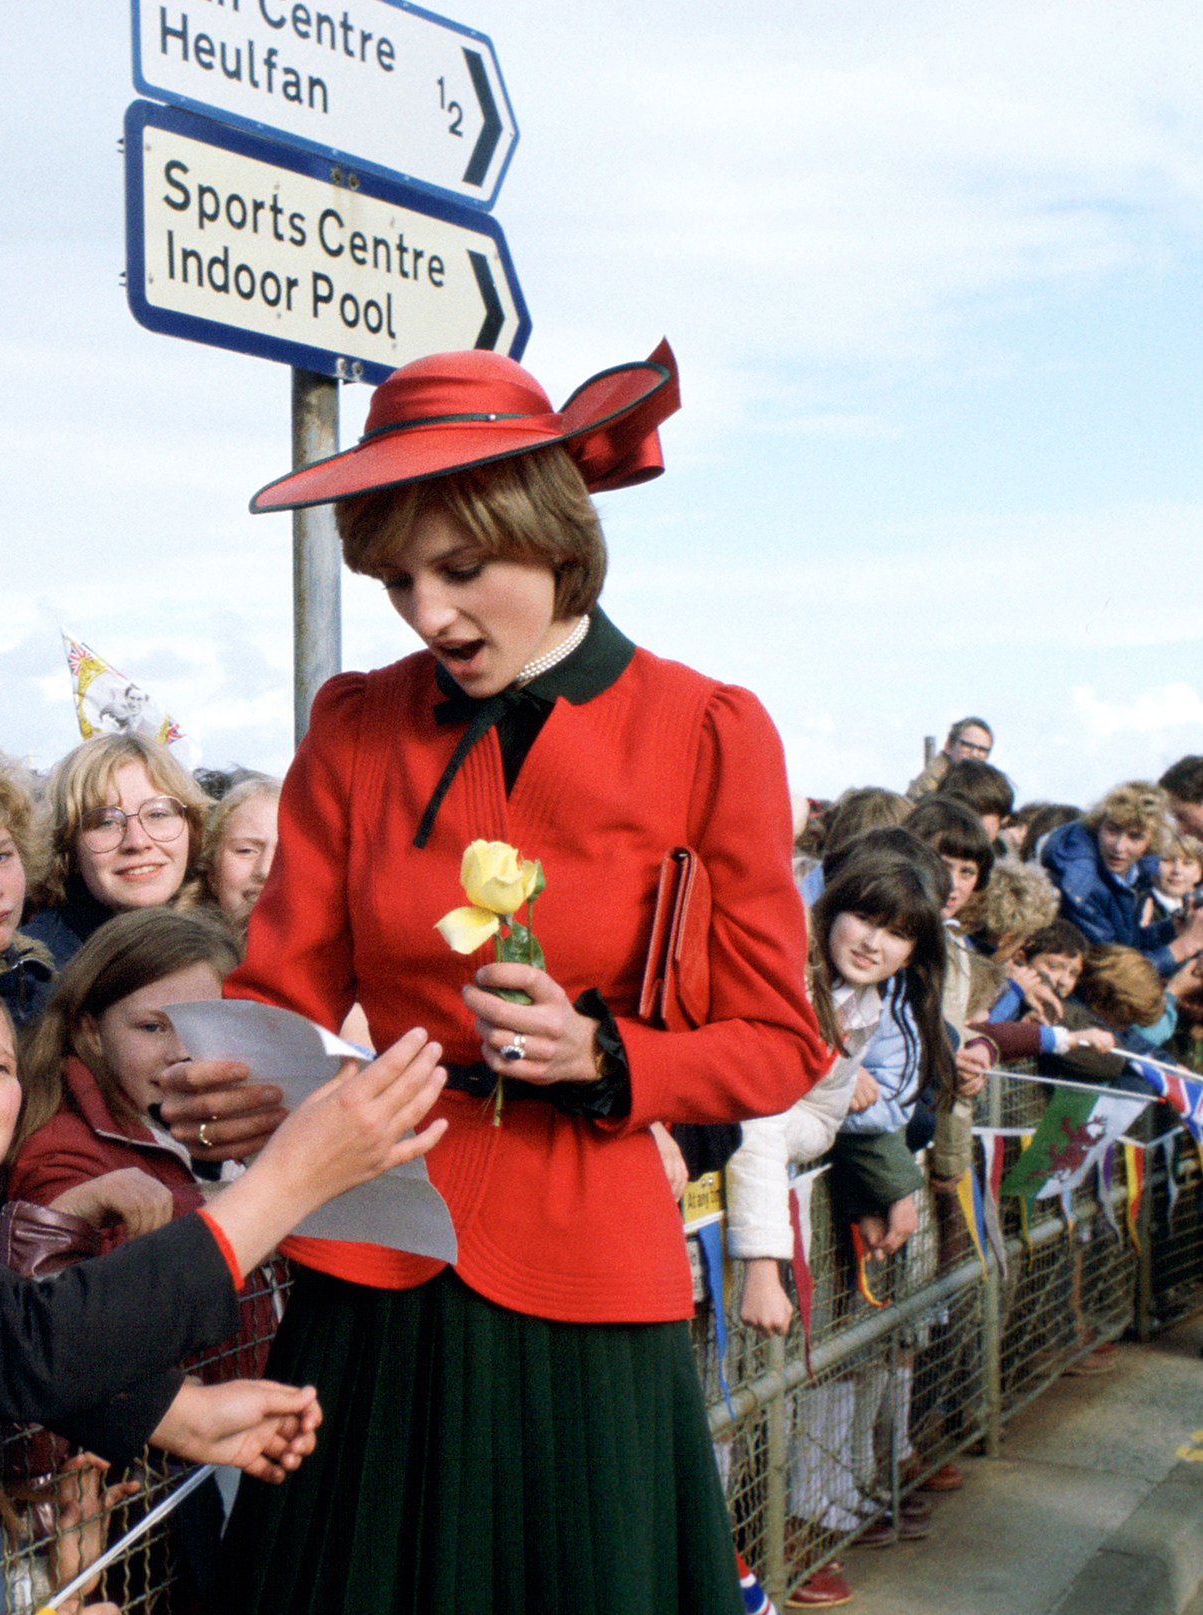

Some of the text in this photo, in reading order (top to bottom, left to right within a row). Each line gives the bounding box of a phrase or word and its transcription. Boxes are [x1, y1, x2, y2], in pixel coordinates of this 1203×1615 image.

[159, 5, 328, 115] Heulfan
[258, 0, 395, 72] Centre
[163, 159, 446, 288] Sports Centre
[167, 229, 397, 340] Indoor Pool
